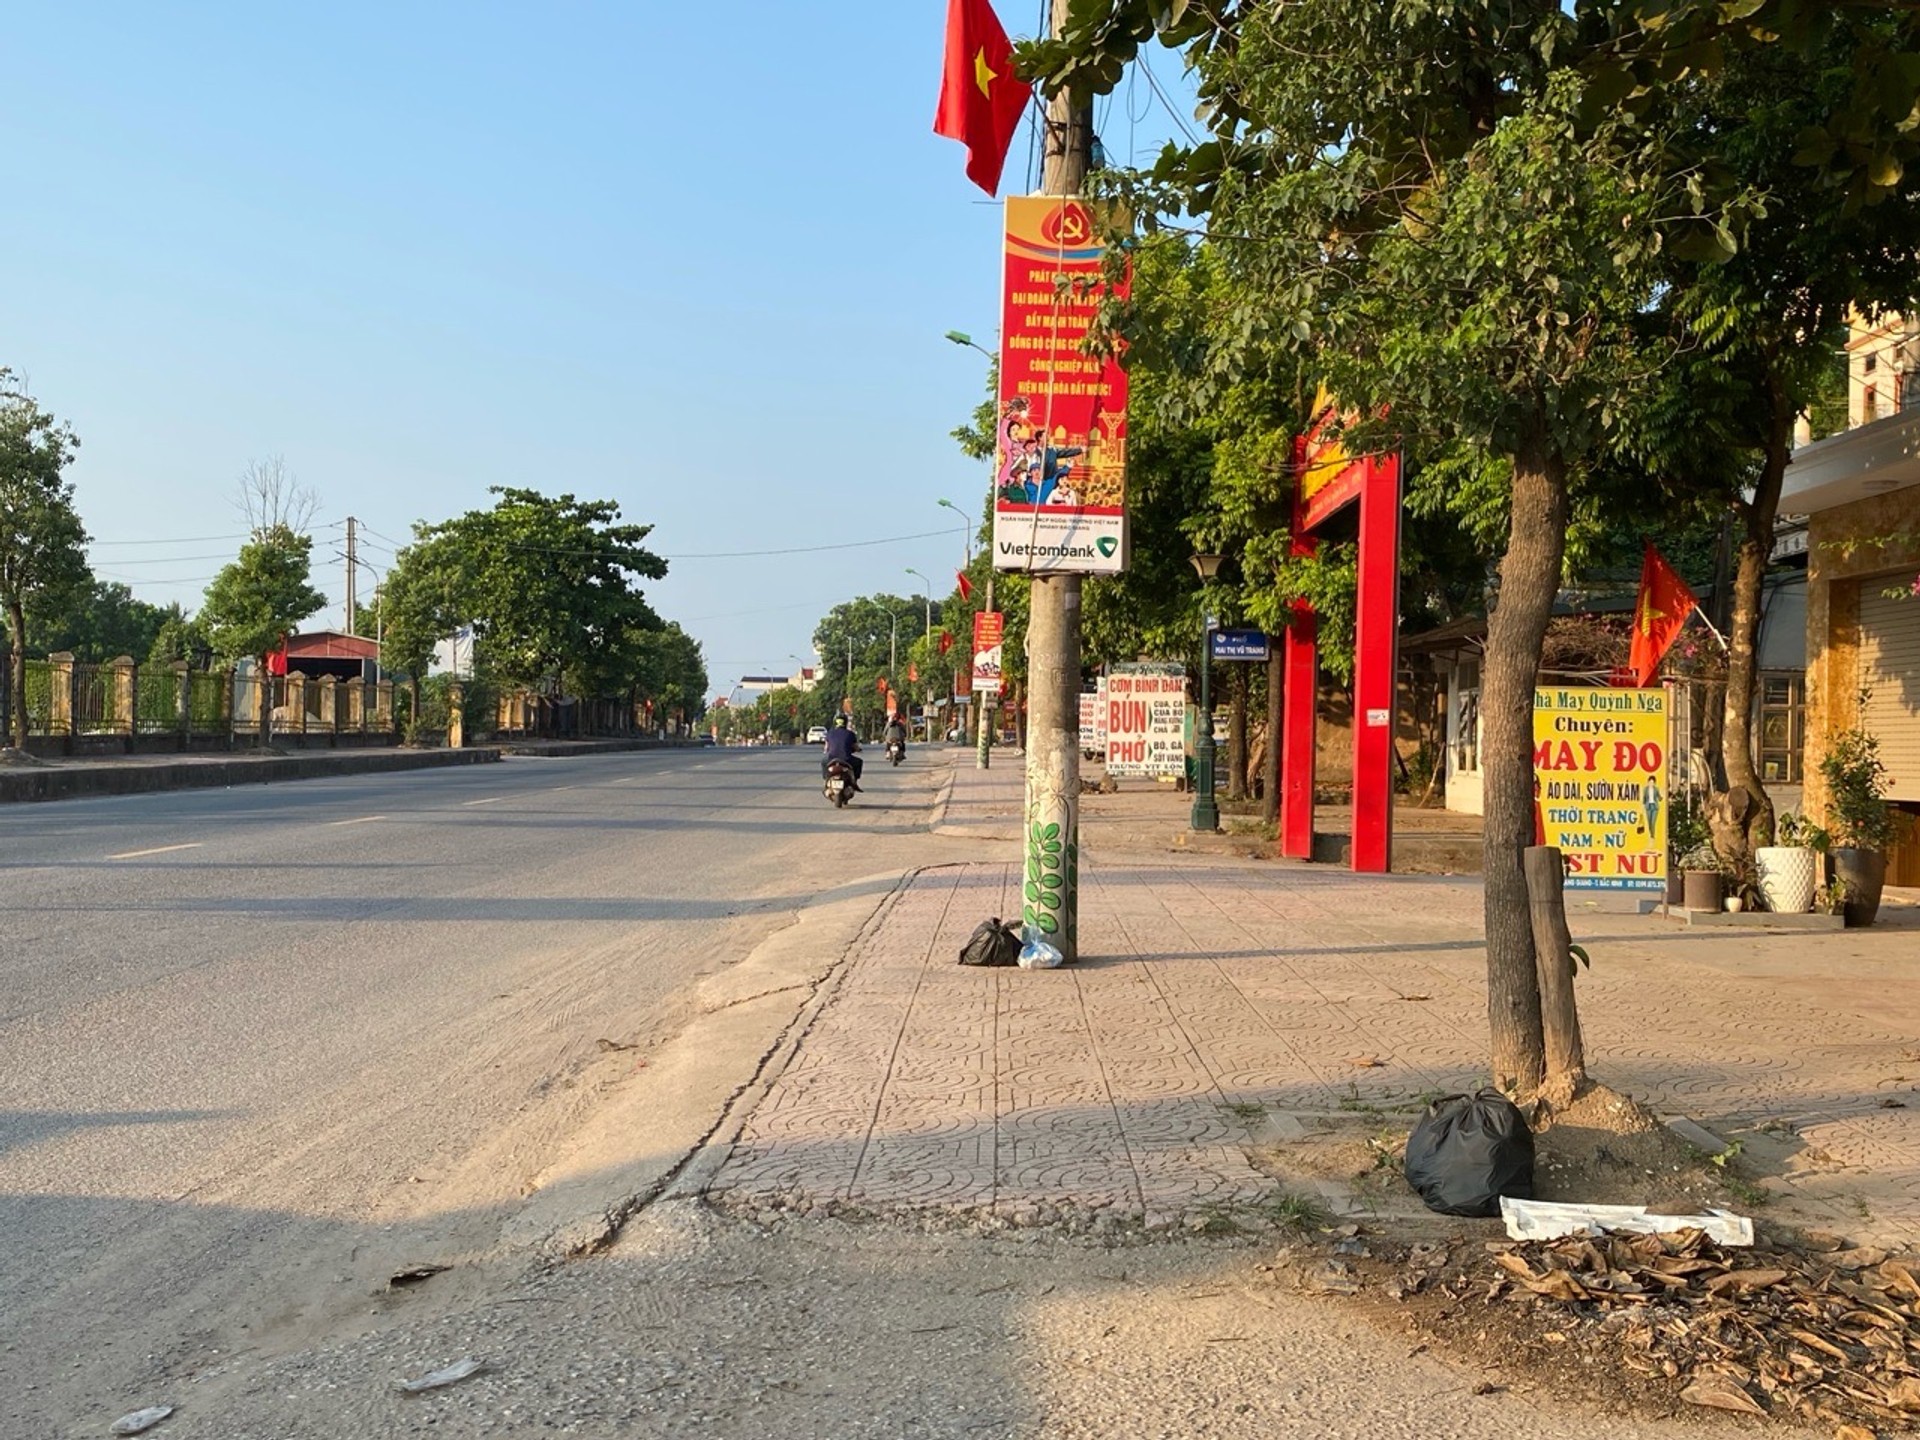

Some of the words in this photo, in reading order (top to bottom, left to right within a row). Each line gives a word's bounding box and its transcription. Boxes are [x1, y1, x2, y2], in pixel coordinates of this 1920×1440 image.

[1029, 269, 1049, 282] PHÁT
[1000, 541, 1095, 558] Vietcombank
[1557, 692, 1585, 712] May
[1590, 692, 1632, 712] Quỳnh
[1637, 693, 1662, 712] Nga
[1110, 693, 1147, 733] BÚN
[1555, 716, 1634, 735] Chuyên:
[1110, 735, 1146, 762] PHỞ
[1534, 740, 1603, 771] MAY
[1613, 741, 1662, 772] ĐO
[1547, 778, 1560, 799] ÁO
[1549, 805, 1583, 823] THỜI
[1587, 811, 1638, 824] TRANG
[1560, 833, 1593, 847] NAM
[1605, 829, 1627, 848] NỮ
[1568, 853, 1604, 873] ST
[1616, 851, 1663, 875] NỮ
